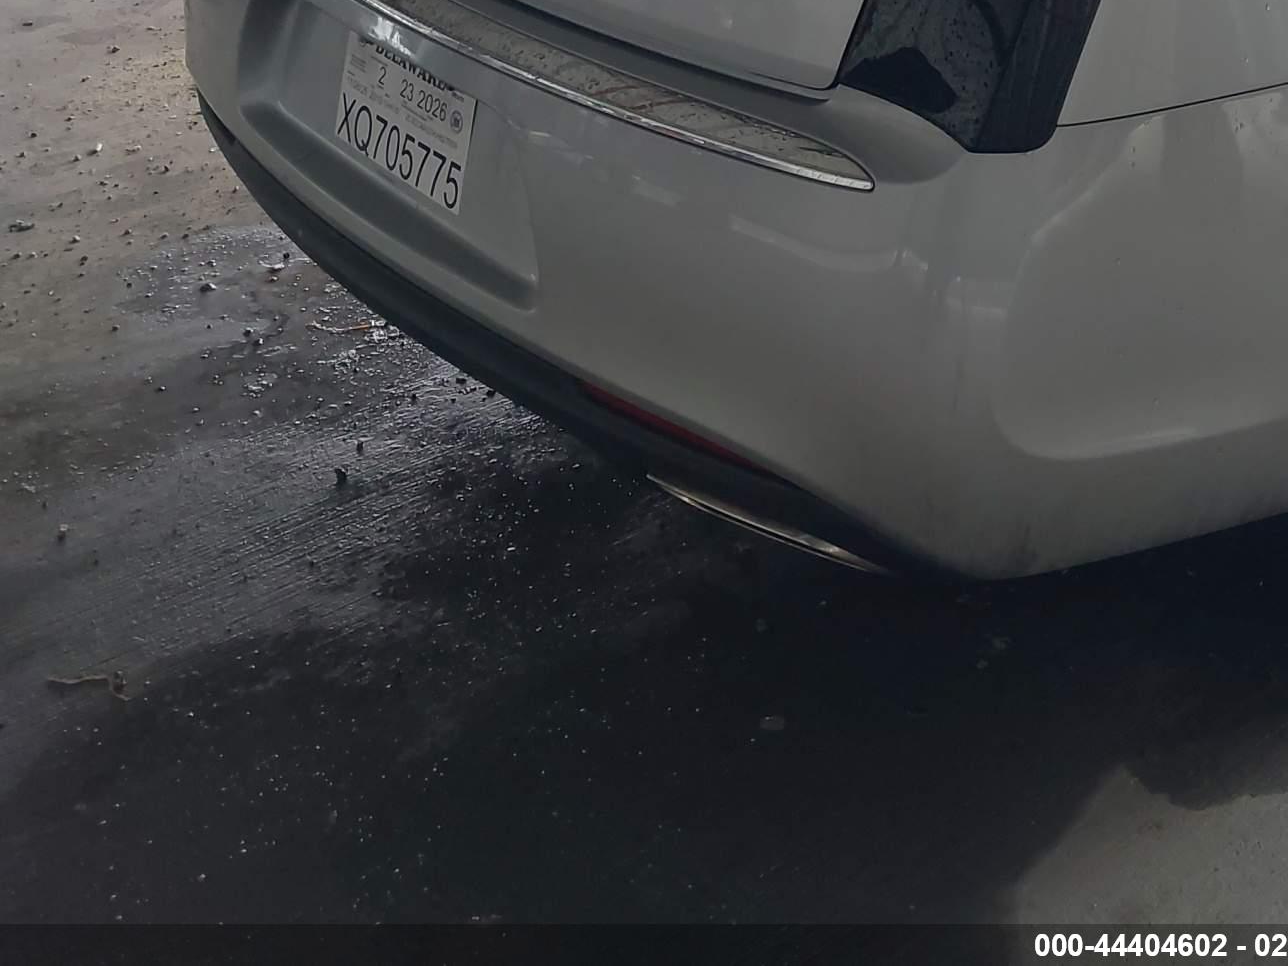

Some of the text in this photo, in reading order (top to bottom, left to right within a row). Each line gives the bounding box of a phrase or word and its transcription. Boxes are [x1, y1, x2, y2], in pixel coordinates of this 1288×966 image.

[378, 65, 387, 85] 2
[399, 79, 415, 102] 23
[417, 90, 448, 122] 2026
[337, 92, 462, 210] XQ705775
